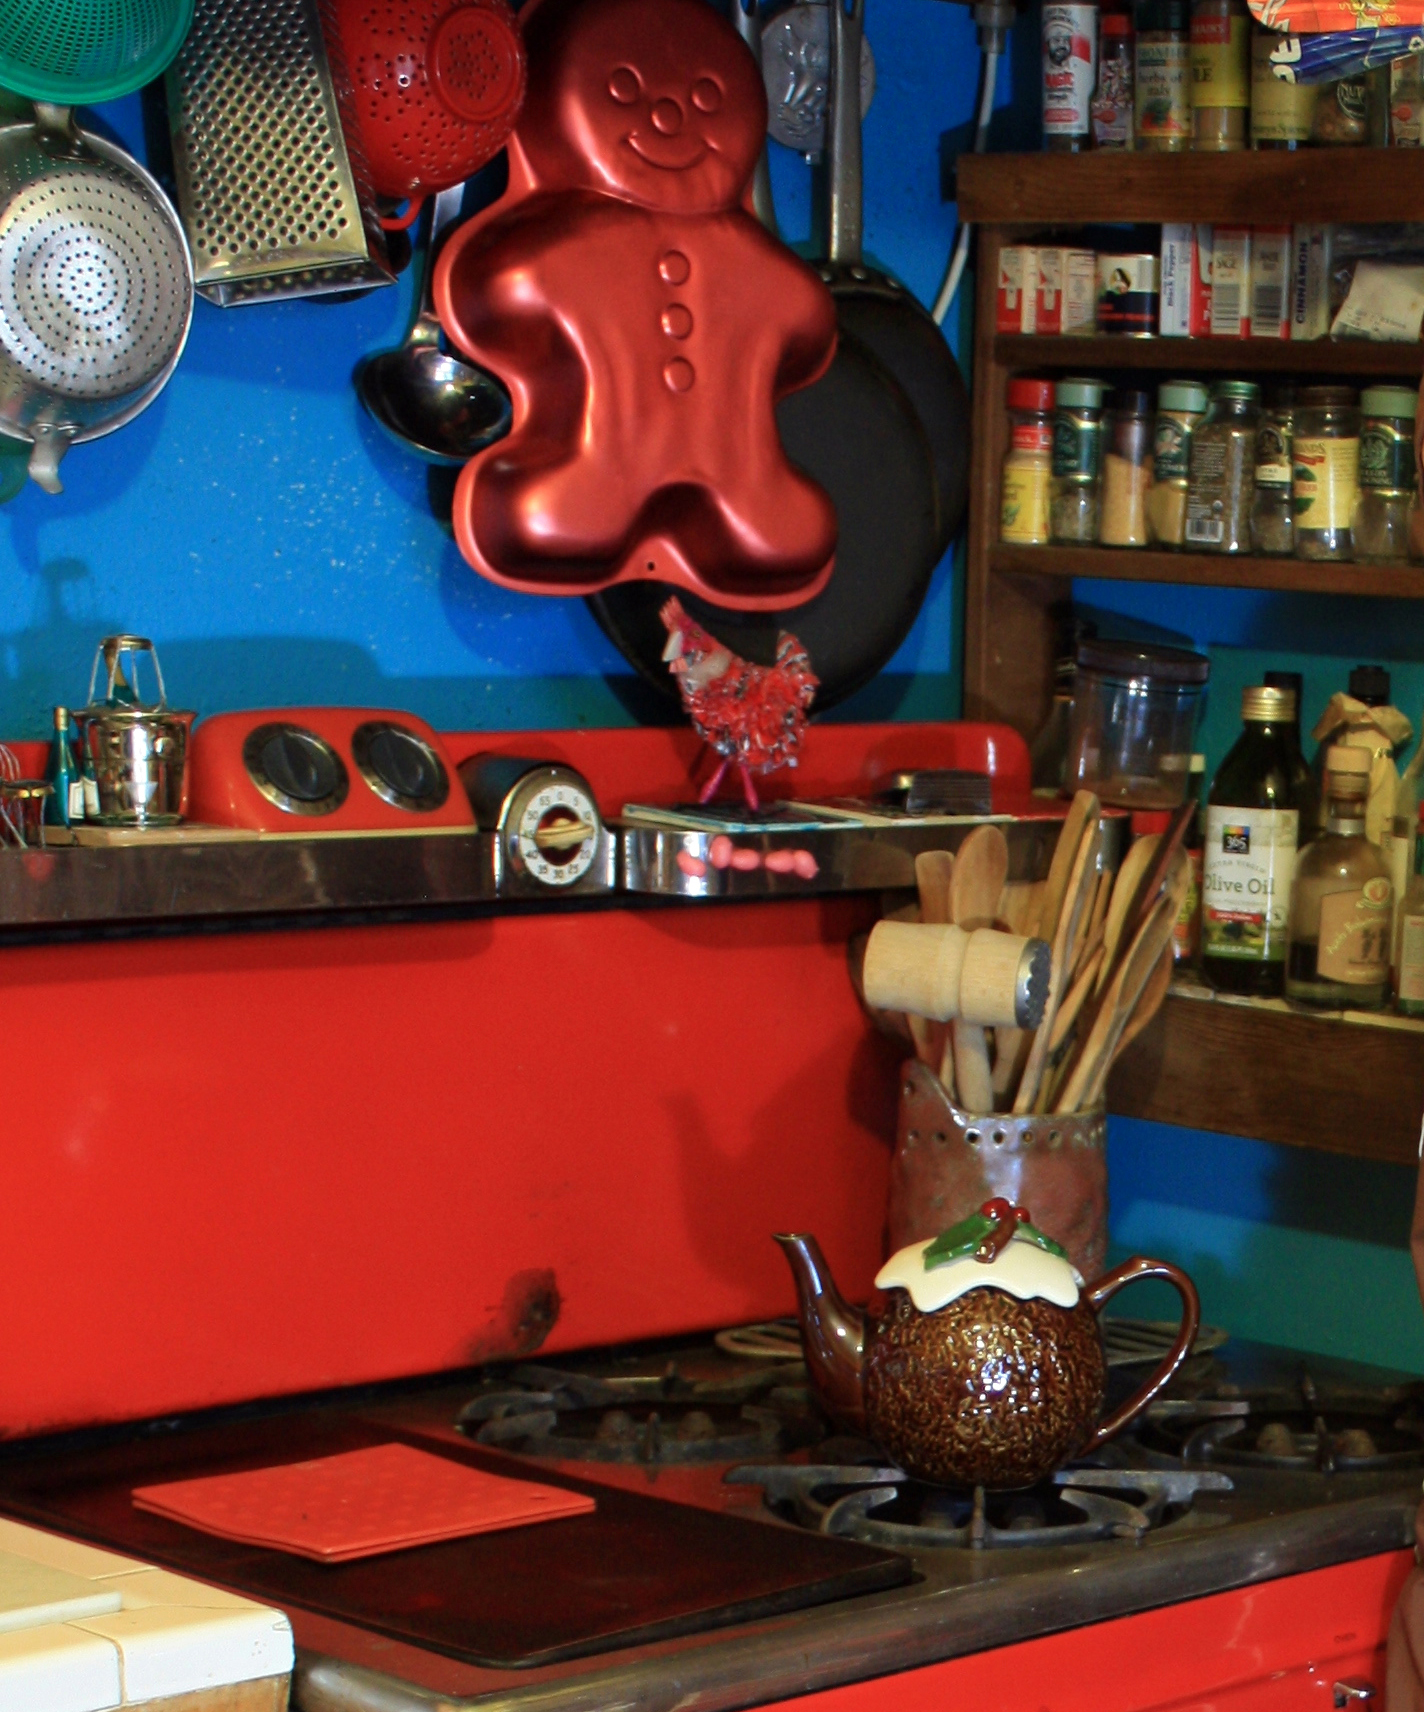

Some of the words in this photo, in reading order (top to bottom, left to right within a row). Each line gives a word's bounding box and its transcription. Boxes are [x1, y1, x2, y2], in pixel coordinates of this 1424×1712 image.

[1295, 242, 1308, 325] CINNAMON
[1205, 873, 1243, 893] Olive
[1247, 877, 1276, 895] Oil
